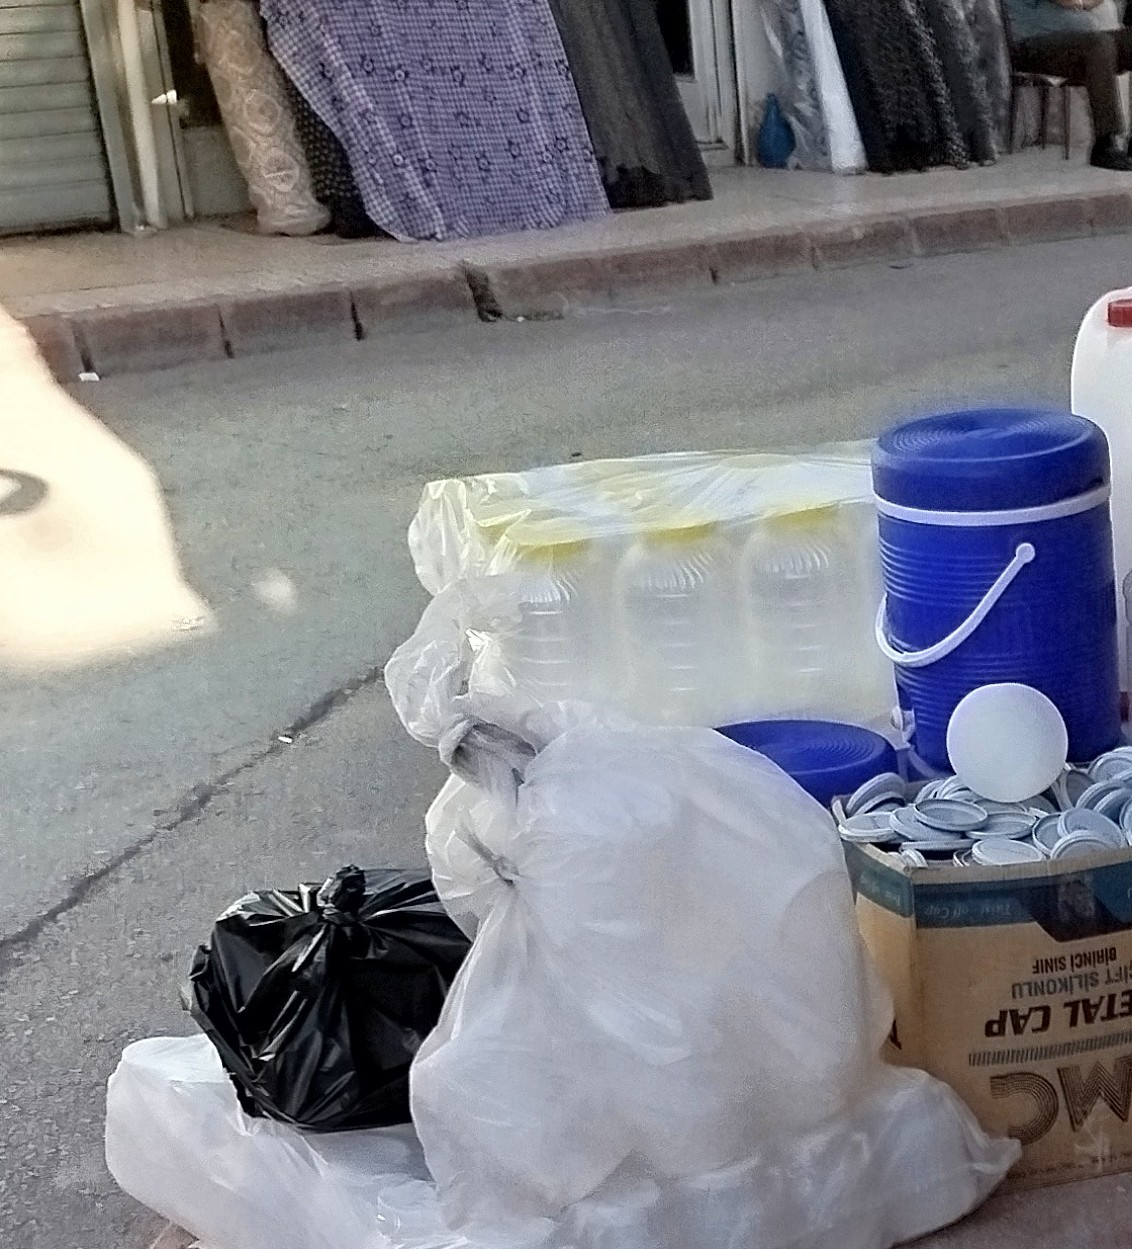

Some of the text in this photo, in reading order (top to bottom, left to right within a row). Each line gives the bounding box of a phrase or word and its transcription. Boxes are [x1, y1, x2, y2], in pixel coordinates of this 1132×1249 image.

[1031, 946, 1117, 976] BİRİNCİ SINIF
[1011, 971, 1100, 1000] SİLİKONLU
[984, 1005, 1051, 1039] CAP
